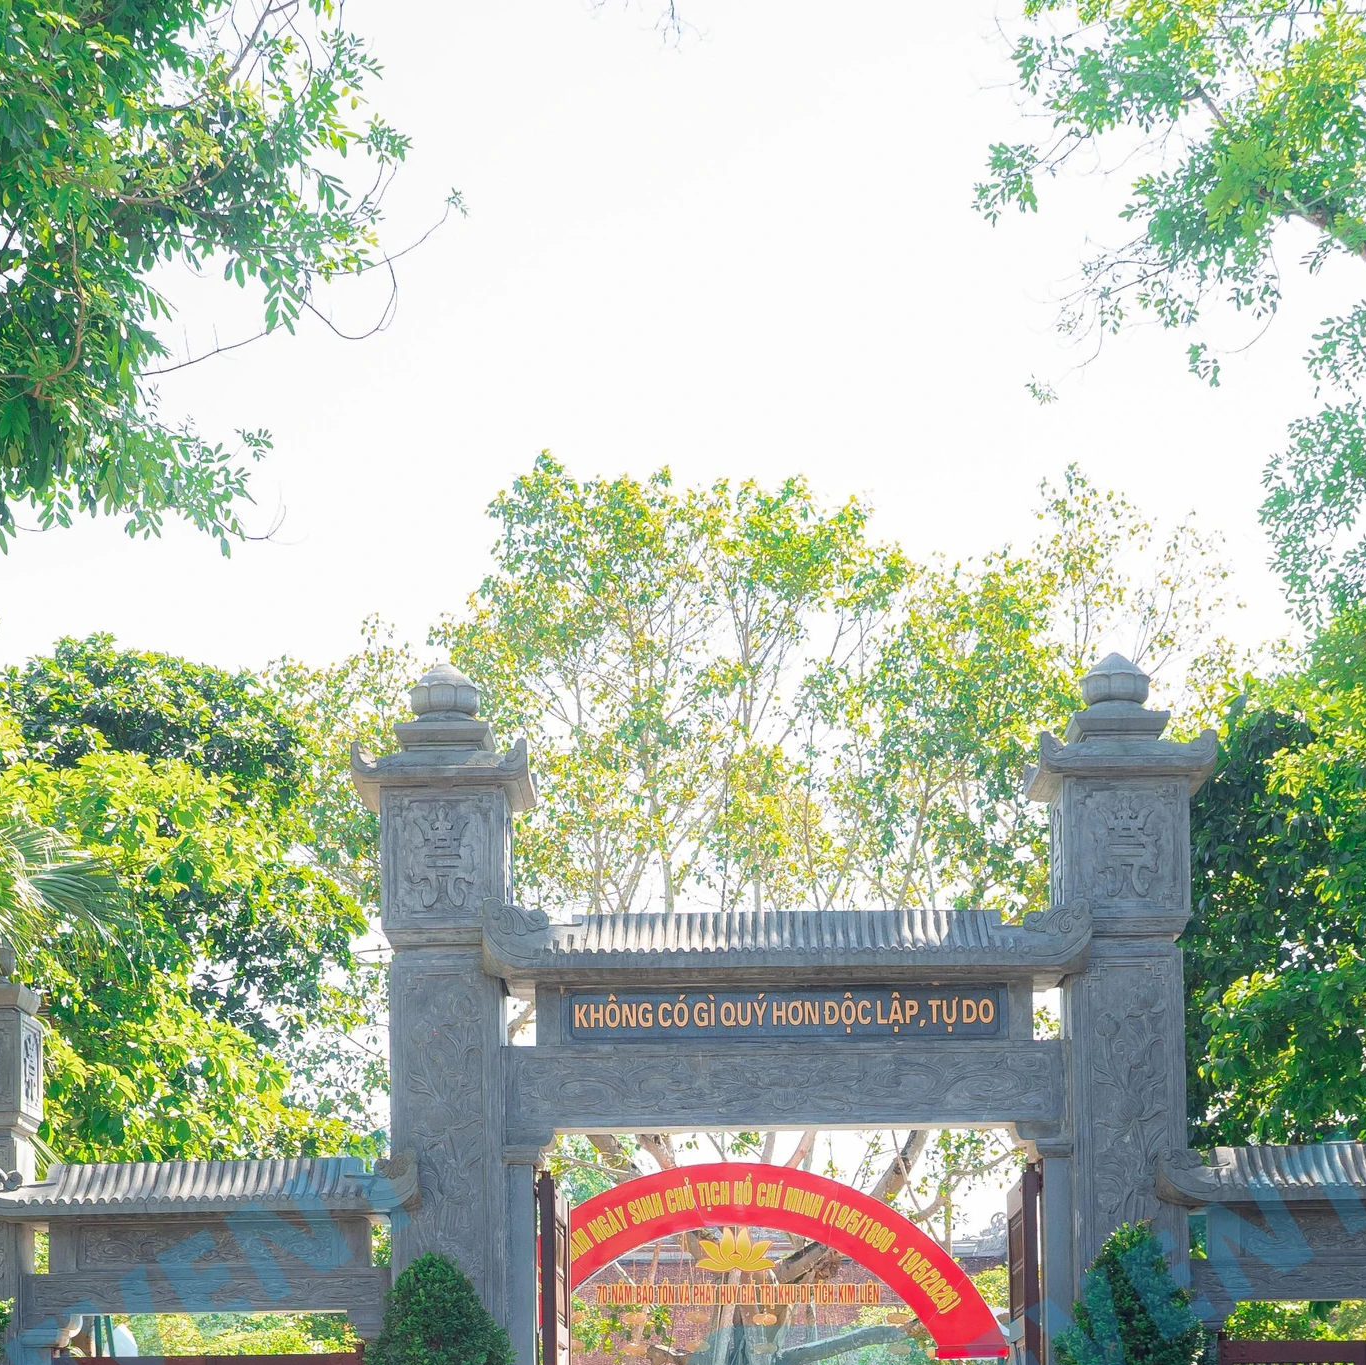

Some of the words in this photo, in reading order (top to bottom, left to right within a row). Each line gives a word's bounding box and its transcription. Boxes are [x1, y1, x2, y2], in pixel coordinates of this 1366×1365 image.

[574, 993, 653, 1028] KHÔNG
[658, 994, 688, 1027] CÓ
[693, 994, 714, 1027] GÌ
[720, 993, 765, 1027] QUÝ
[772, 999, 820, 1026] HƠN
[824, 992, 871, 1033] ĐỘC
[928, 996, 958, 1033] TỰ
[963, 998, 994, 1024] DO
[588, 1206, 628, 1243] NGÀY
[627, 1192, 663, 1225] SINH
[665, 1177, 698, 1213] CHỦ
[697, 1182, 729, 1211] TỊCH
[733, 1174, 752, 1206] HỒ
[756, 1180, 783, 1208] CHÍ
[783, 1187, 824, 1218] MINH
[822, 1200, 897, 1253] (19/5/1890
[897, 1246, 961, 1314] 19/5/2026)
[596, 1284, 608, 1304] 70
[611, 1279, 632, 1304] NĂM
[635, 1278, 654, 1304] BẢO
[657, 1278, 675, 1304] TỒN
[678, 1280, 691, 1304] VÀ
[693, 1280, 716, 1304] PHÁT
[719, 1284, 738, 1304] HUY
[740, 1280, 756, 1304] GIÁ
[759, 1284, 775, 1309] TRỊ
[777, 1284, 796, 1304] KHU
[800, 1284, 810, 1304] DI
[814, 1280, 833, 1304] TÍCH
[838, 1284, 856, 1304] KIM
[859, 1279, 880, 1304] LIÊN
